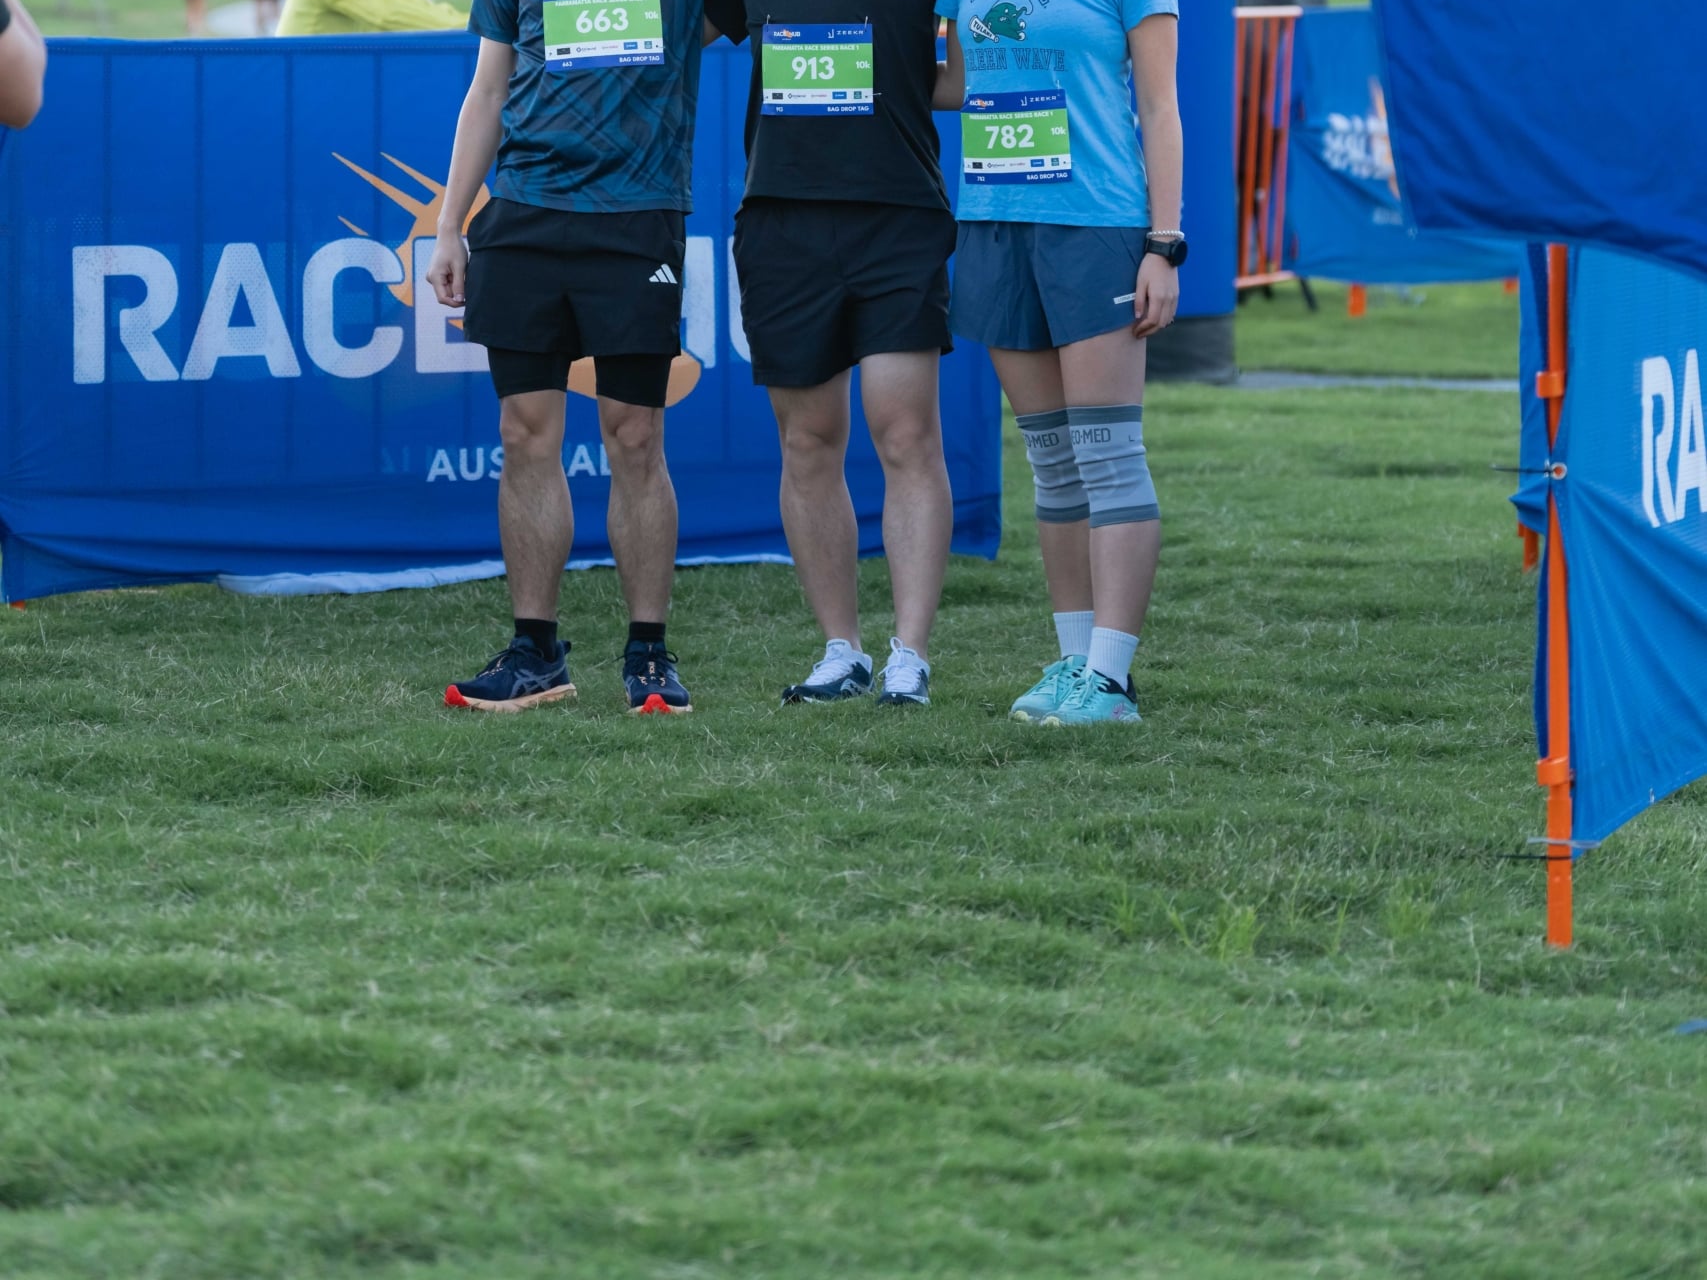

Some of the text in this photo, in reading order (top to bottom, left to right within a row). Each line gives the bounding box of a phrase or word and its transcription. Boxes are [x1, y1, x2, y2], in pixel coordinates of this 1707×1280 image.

[575, 7, 629, 34] 663
[791, 56, 835, 80] 913
[967, 47, 1065, 72] REEN WAVE
[984, 124, 1035, 149] 782
